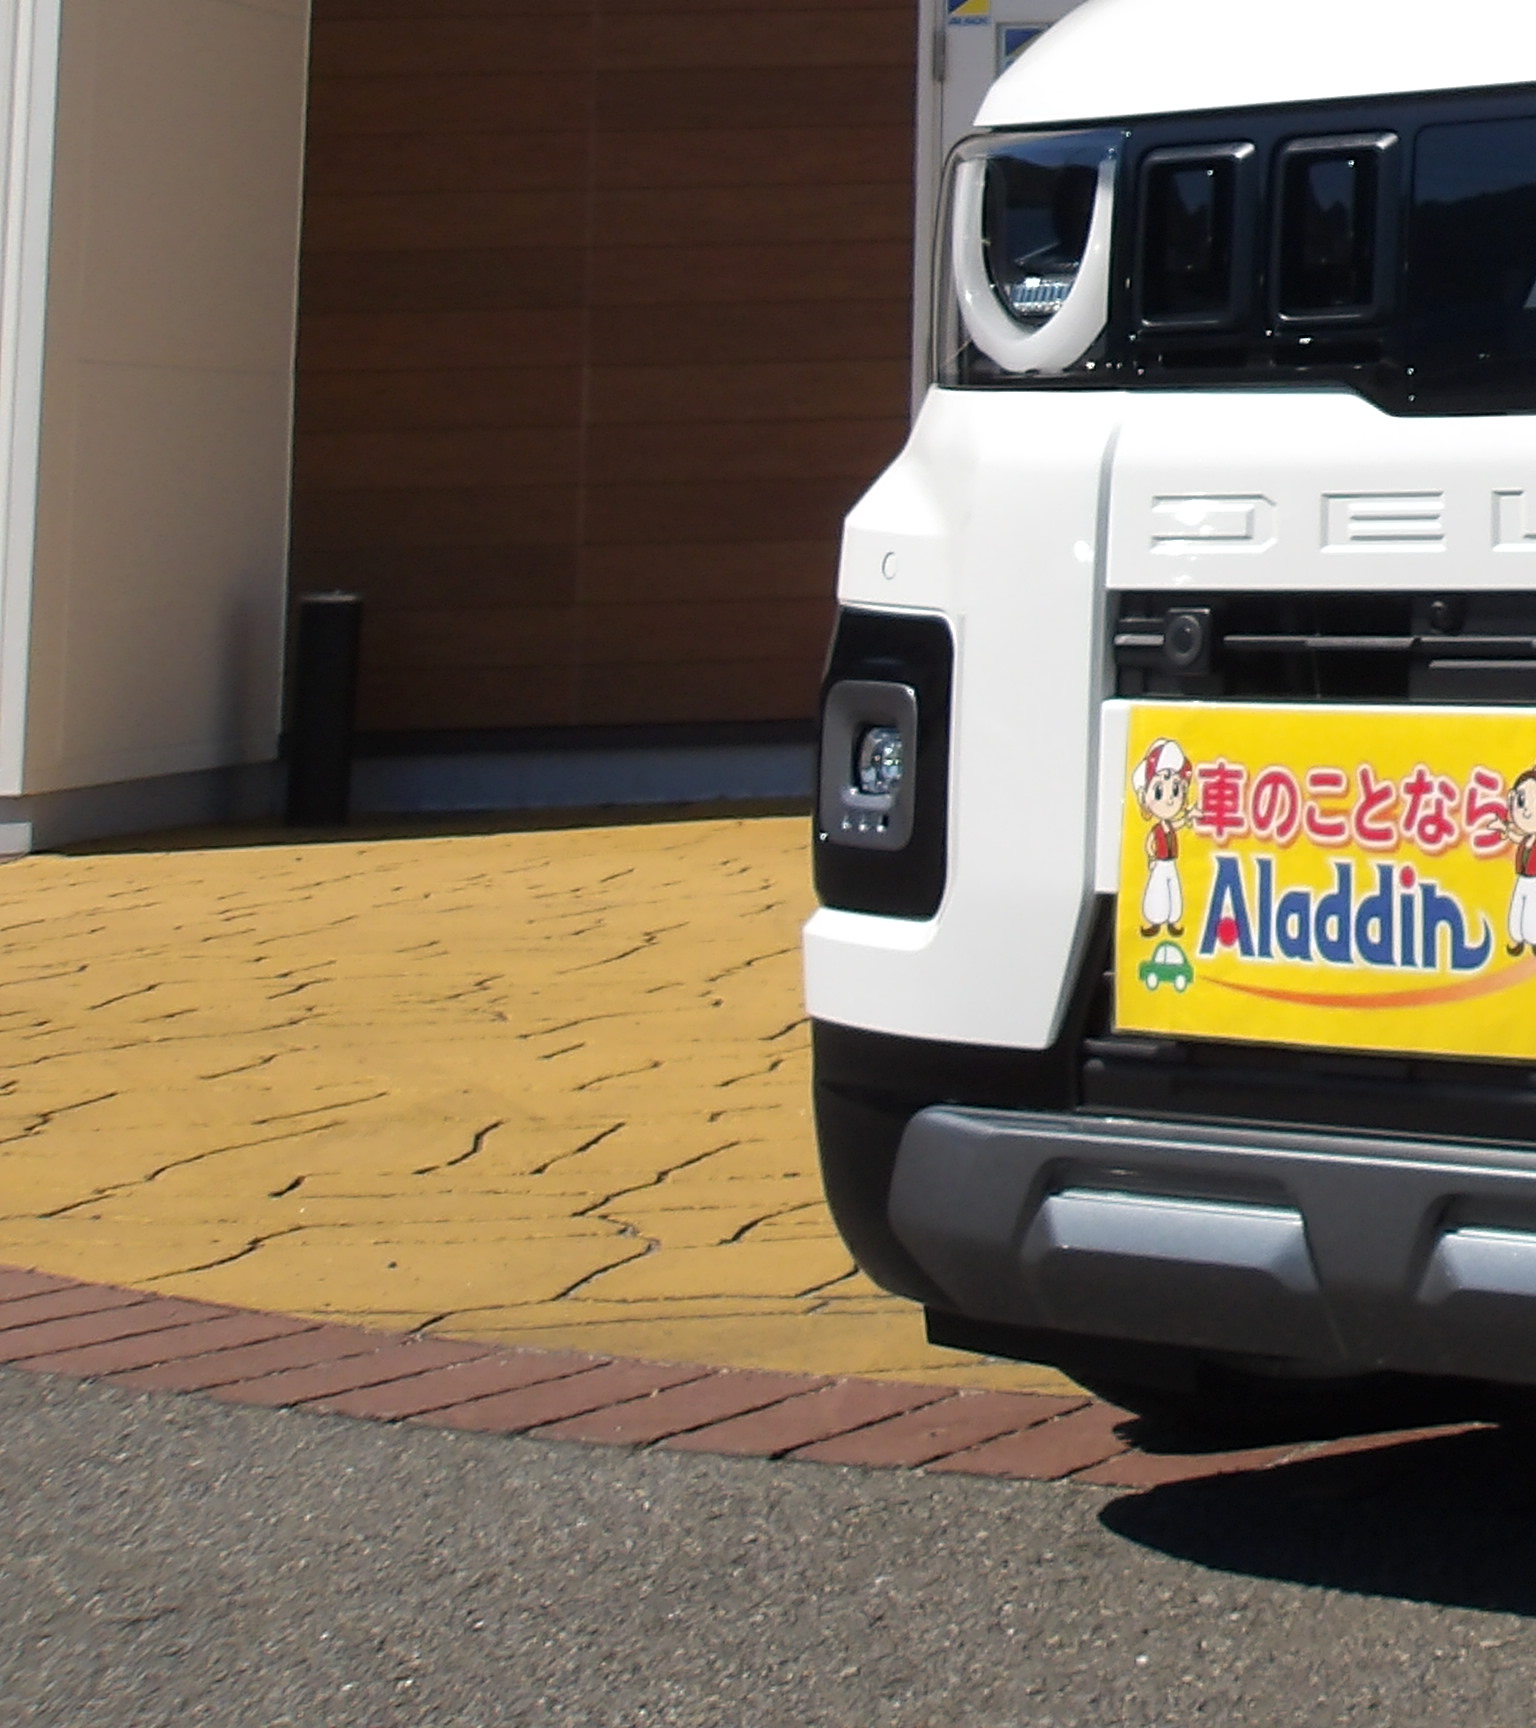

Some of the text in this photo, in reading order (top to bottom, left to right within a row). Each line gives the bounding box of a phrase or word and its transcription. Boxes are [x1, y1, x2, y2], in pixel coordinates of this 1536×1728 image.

[1198, 758, 1512, 850] 車のことなら
[1199, 855, 1492, 971] Aladdin
